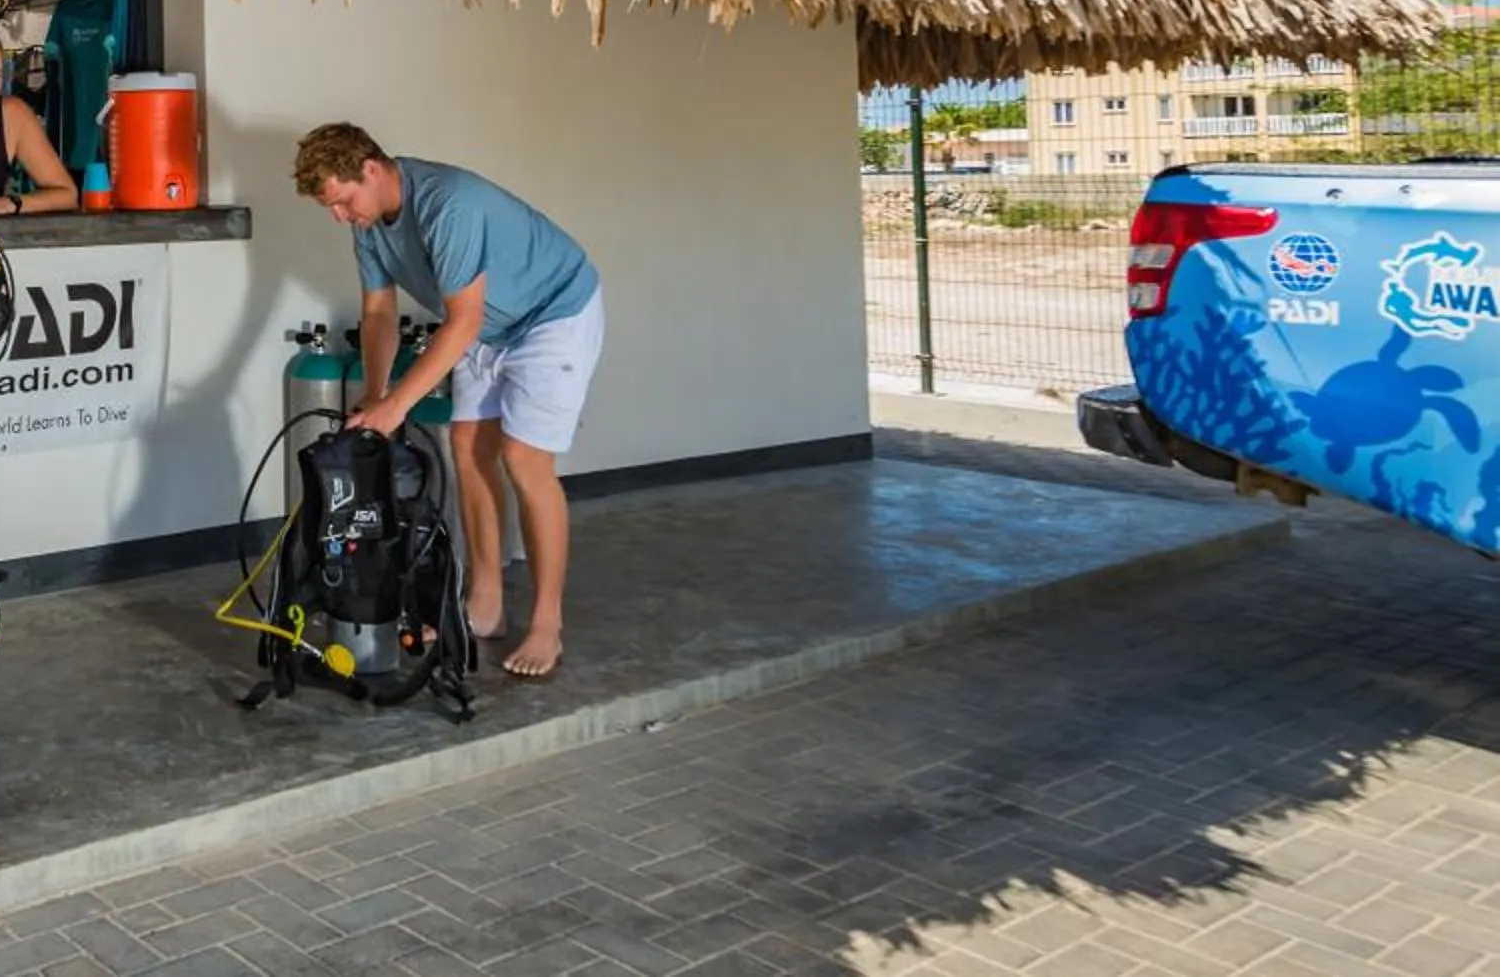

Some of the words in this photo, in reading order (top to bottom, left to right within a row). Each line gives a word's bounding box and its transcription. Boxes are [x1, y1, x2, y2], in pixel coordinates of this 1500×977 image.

[1268, 298, 1340, 326] PADI
[26, 415, 72, 432] Learns
[76, 408, 93, 425] To
[98, 406, 128, 424] Dive
